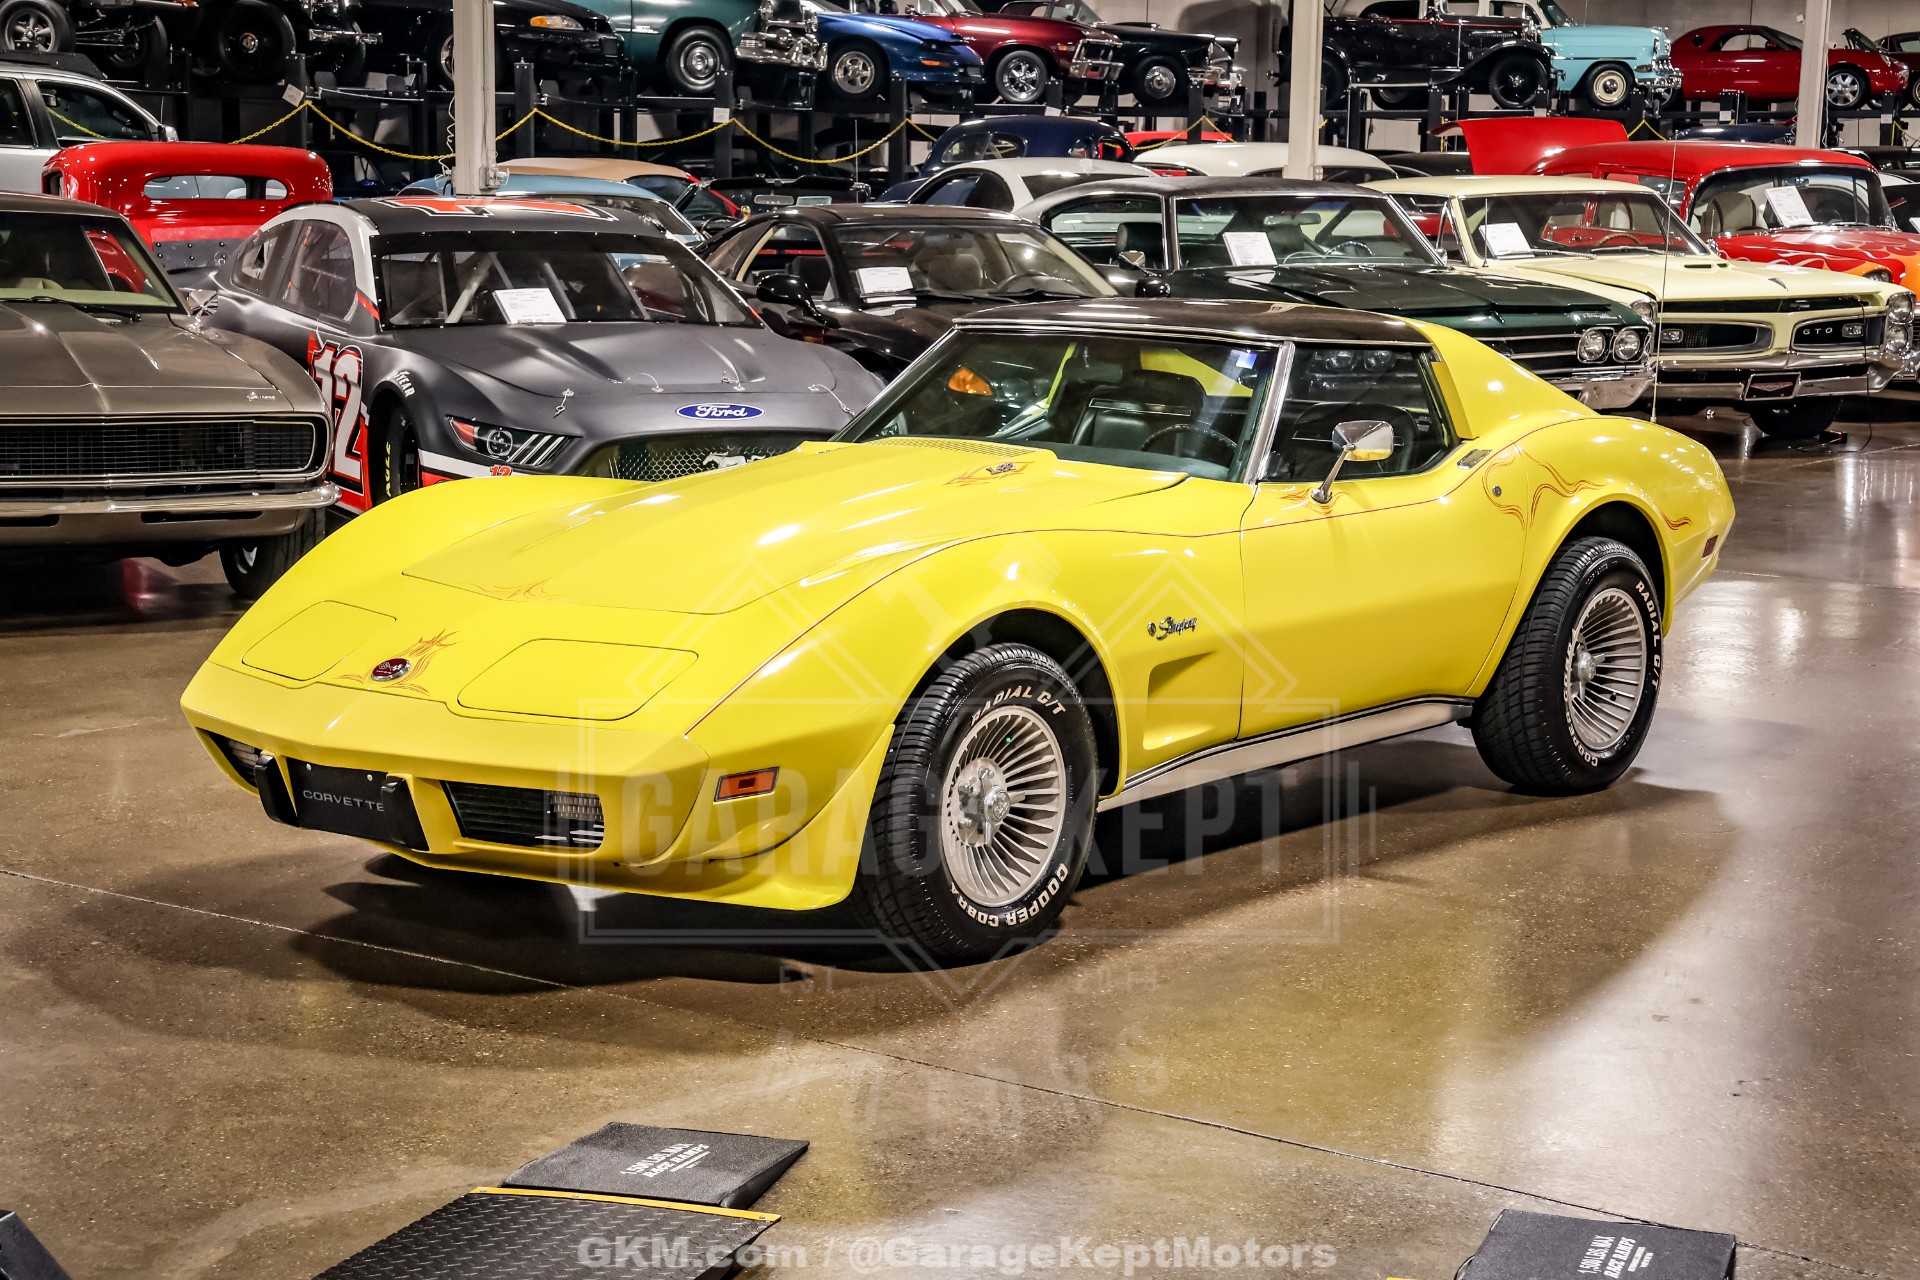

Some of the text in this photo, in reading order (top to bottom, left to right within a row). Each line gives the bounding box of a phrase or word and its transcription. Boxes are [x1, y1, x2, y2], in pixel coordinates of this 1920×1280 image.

[1802, 327, 1833, 336] GTO
[313, 342, 363, 493] 12
[695, 404, 748, 418] Ford
[490, 464, 513, 477] 12
[1635, 580, 1661, 648] RADIAL
[970, 685, 1068, 728] RADIAL G/T
[303, 789, 385, 812] CORVETTE
[950, 862, 1069, 928] COOPER COBRA
[1612, 1236, 1637, 1261] RAMPS
[1603, 1258, 1626, 1279] RACE
